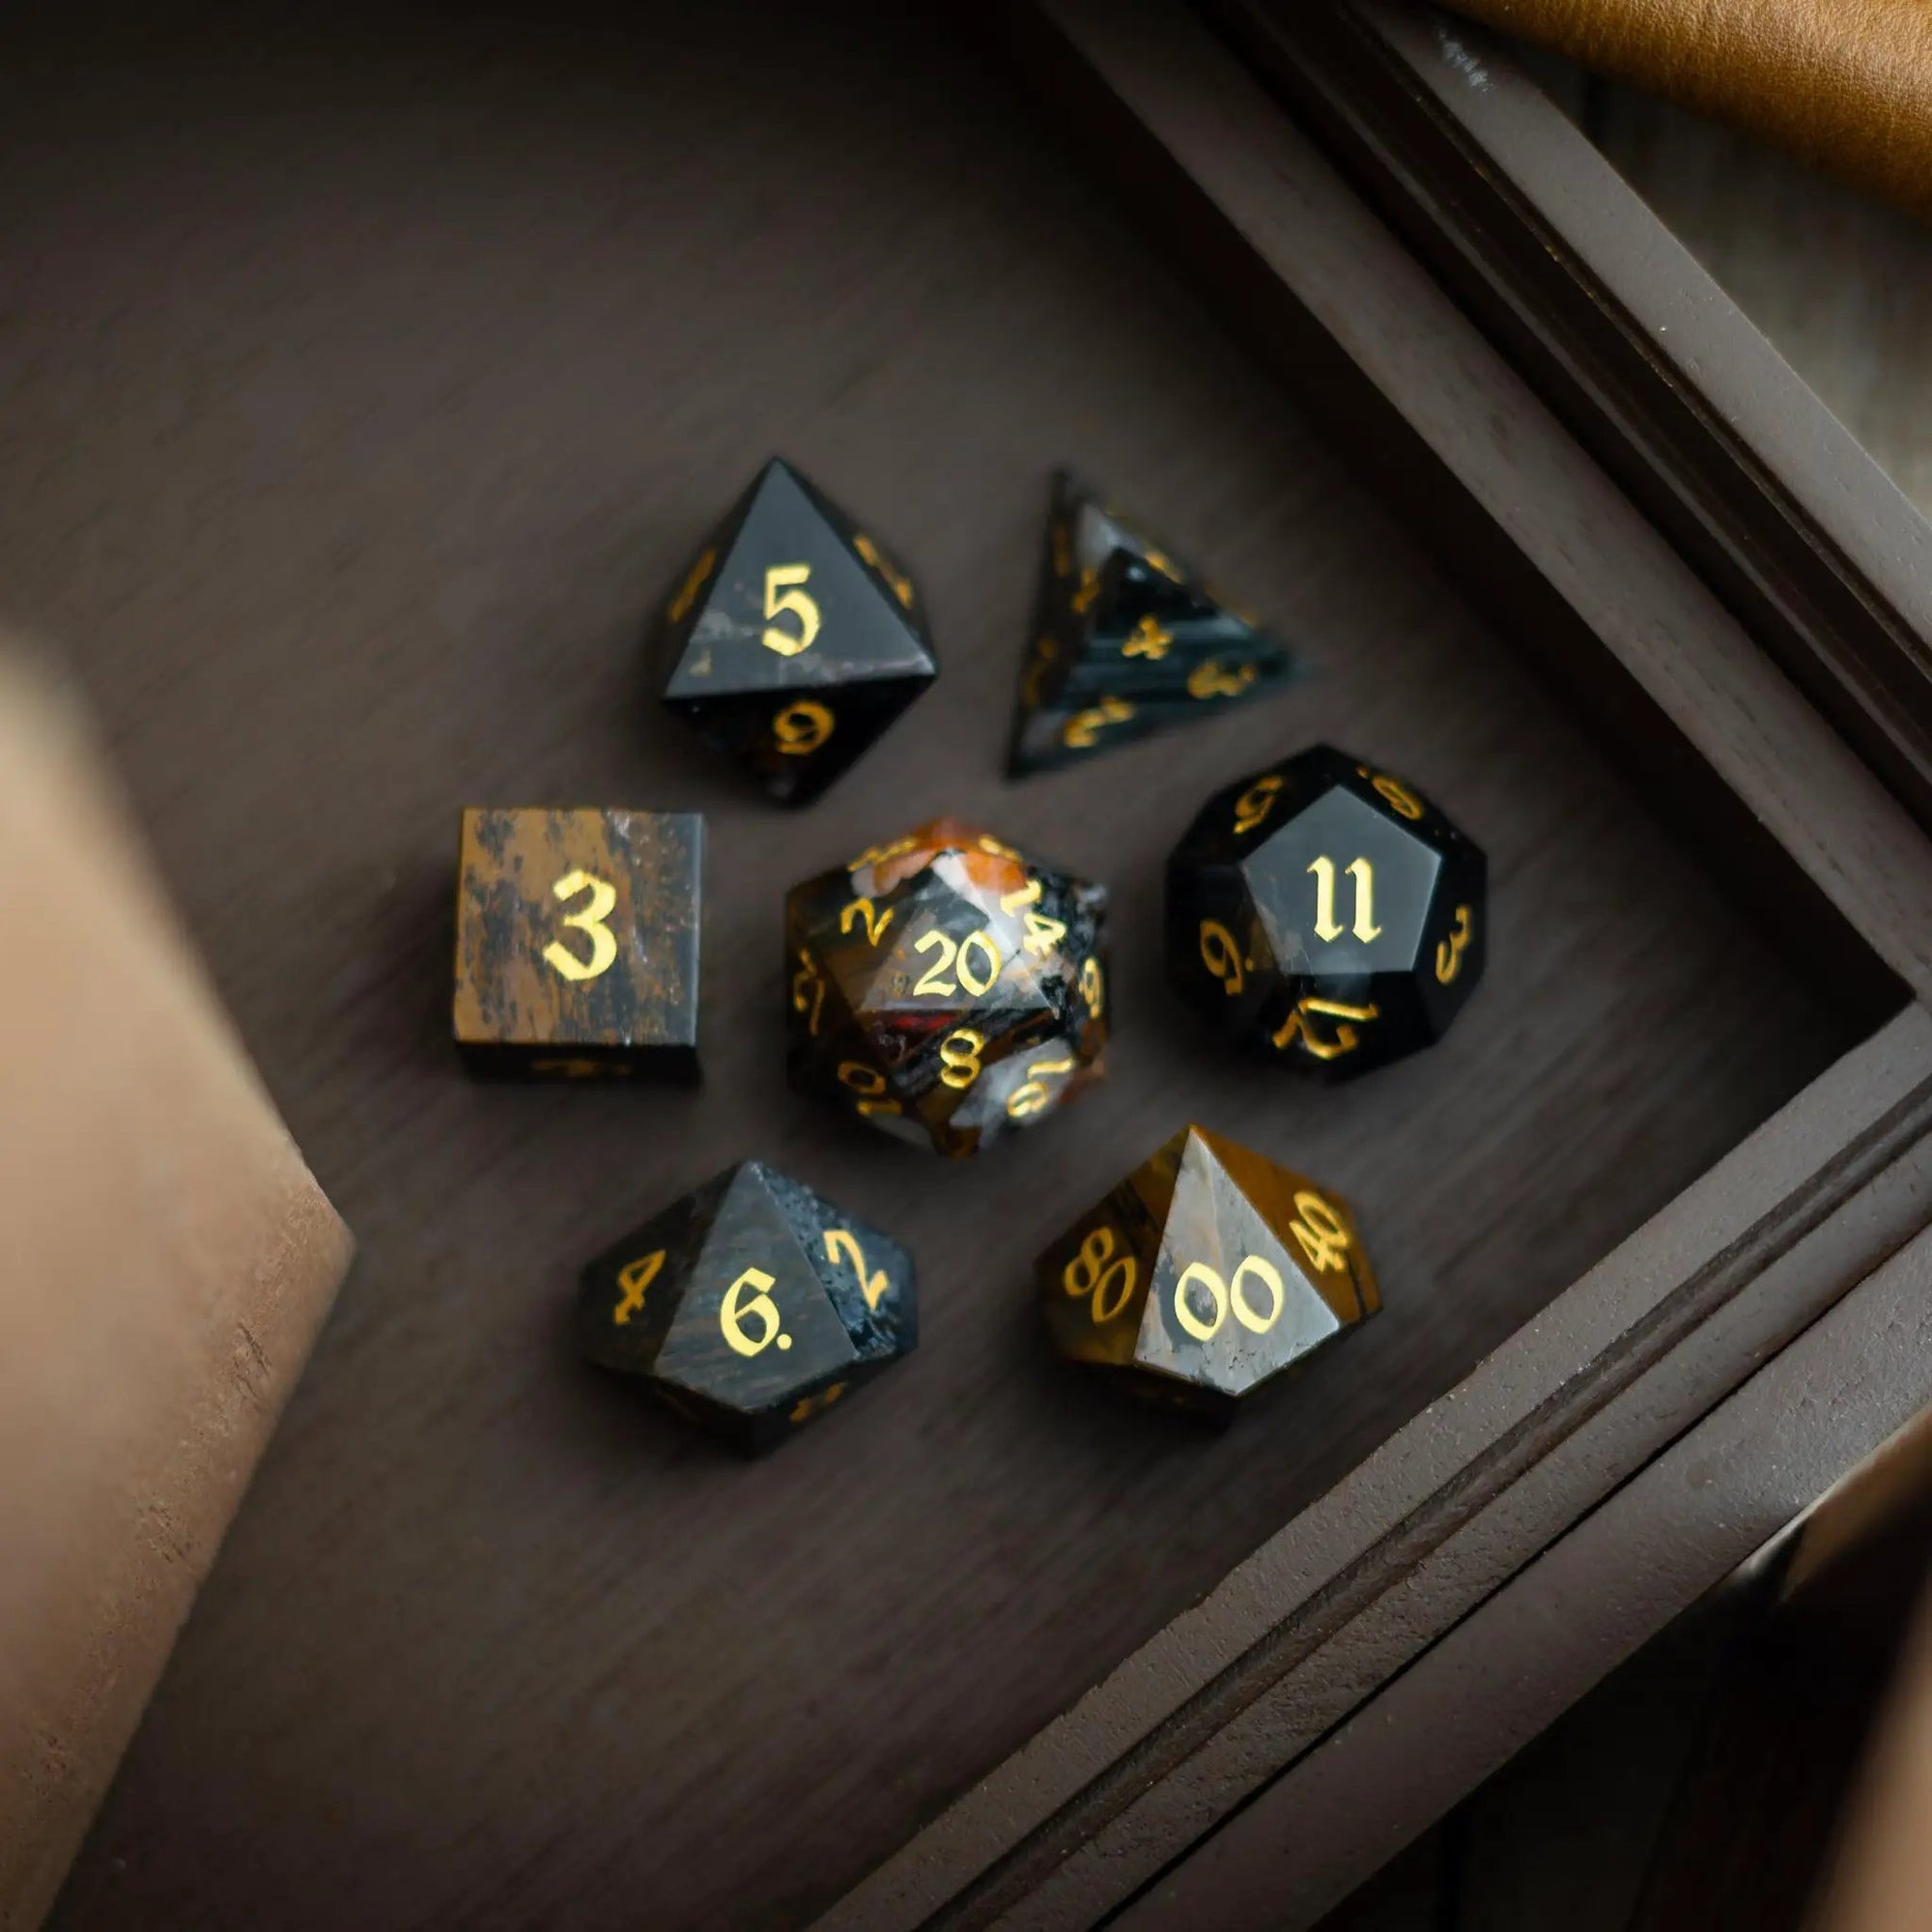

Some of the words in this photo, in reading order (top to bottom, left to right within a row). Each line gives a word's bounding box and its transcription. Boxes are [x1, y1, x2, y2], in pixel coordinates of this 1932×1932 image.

[762, 563, 820, 657] 5
[542, 867, 617, 981] 3
[840, 897, 895, 948] 2
[999, 879, 1067, 955] 14
[1306, 855, 1382, 944] 11
[912, 929, 1002, 998] 20
[1435, 903, 1471, 986] 3
[940, 1029, 984, 1089] 8
[823, 1229, 889, 1314] 2
[1288, 1189, 1349, 1274] 40
[611, 1249, 667, 1325] 4
[1064, 1225, 1137, 1324] 80
[1174, 1254, 1285, 1343] 00
